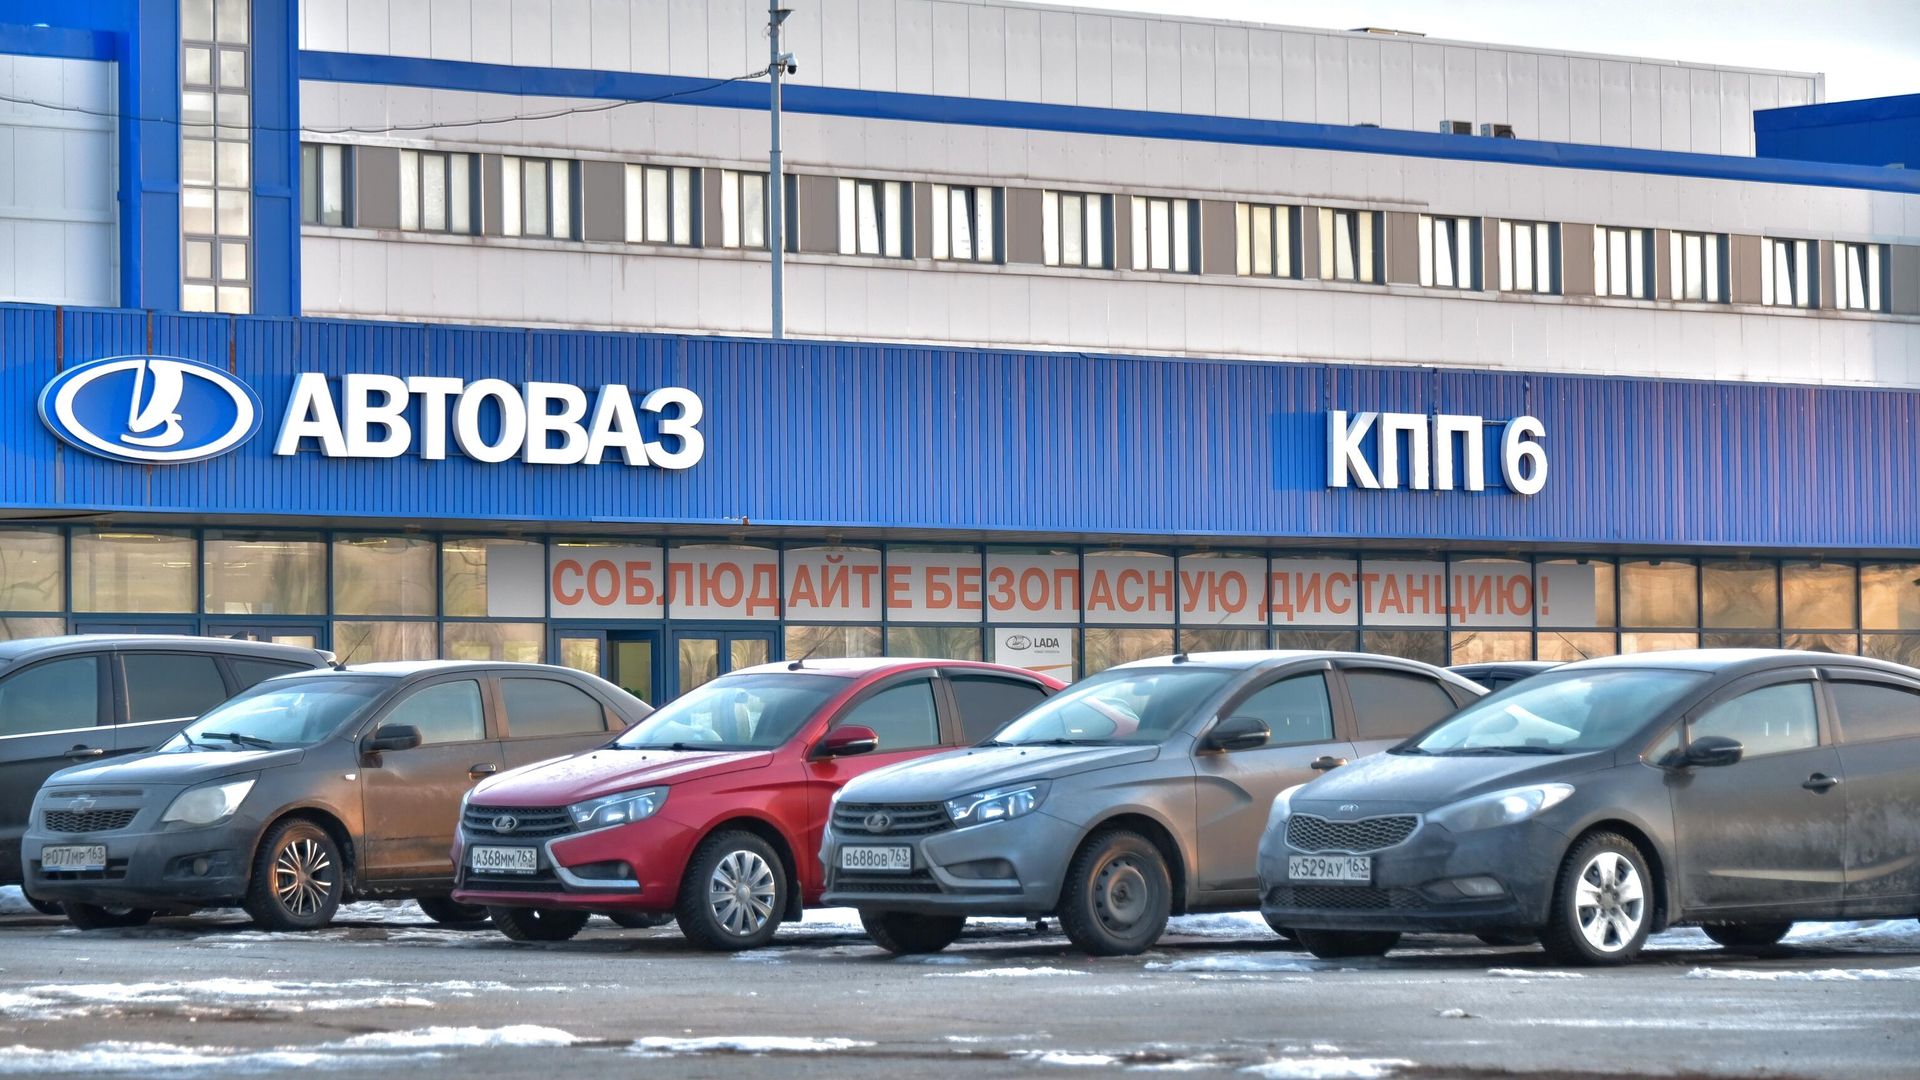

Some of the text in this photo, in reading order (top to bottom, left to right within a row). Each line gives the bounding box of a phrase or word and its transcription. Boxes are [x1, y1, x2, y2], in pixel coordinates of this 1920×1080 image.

[274, 372, 705, 470] АВТОВАЗ
[1327, 410, 1548, 495] КПП 6
[551, 555, 1550, 623] СОБЛЮДАЙТЕ БЕЗОПАСНУЮ ДИСТАНЦИЮ!
[1034, 638, 1060, 648] LADA
